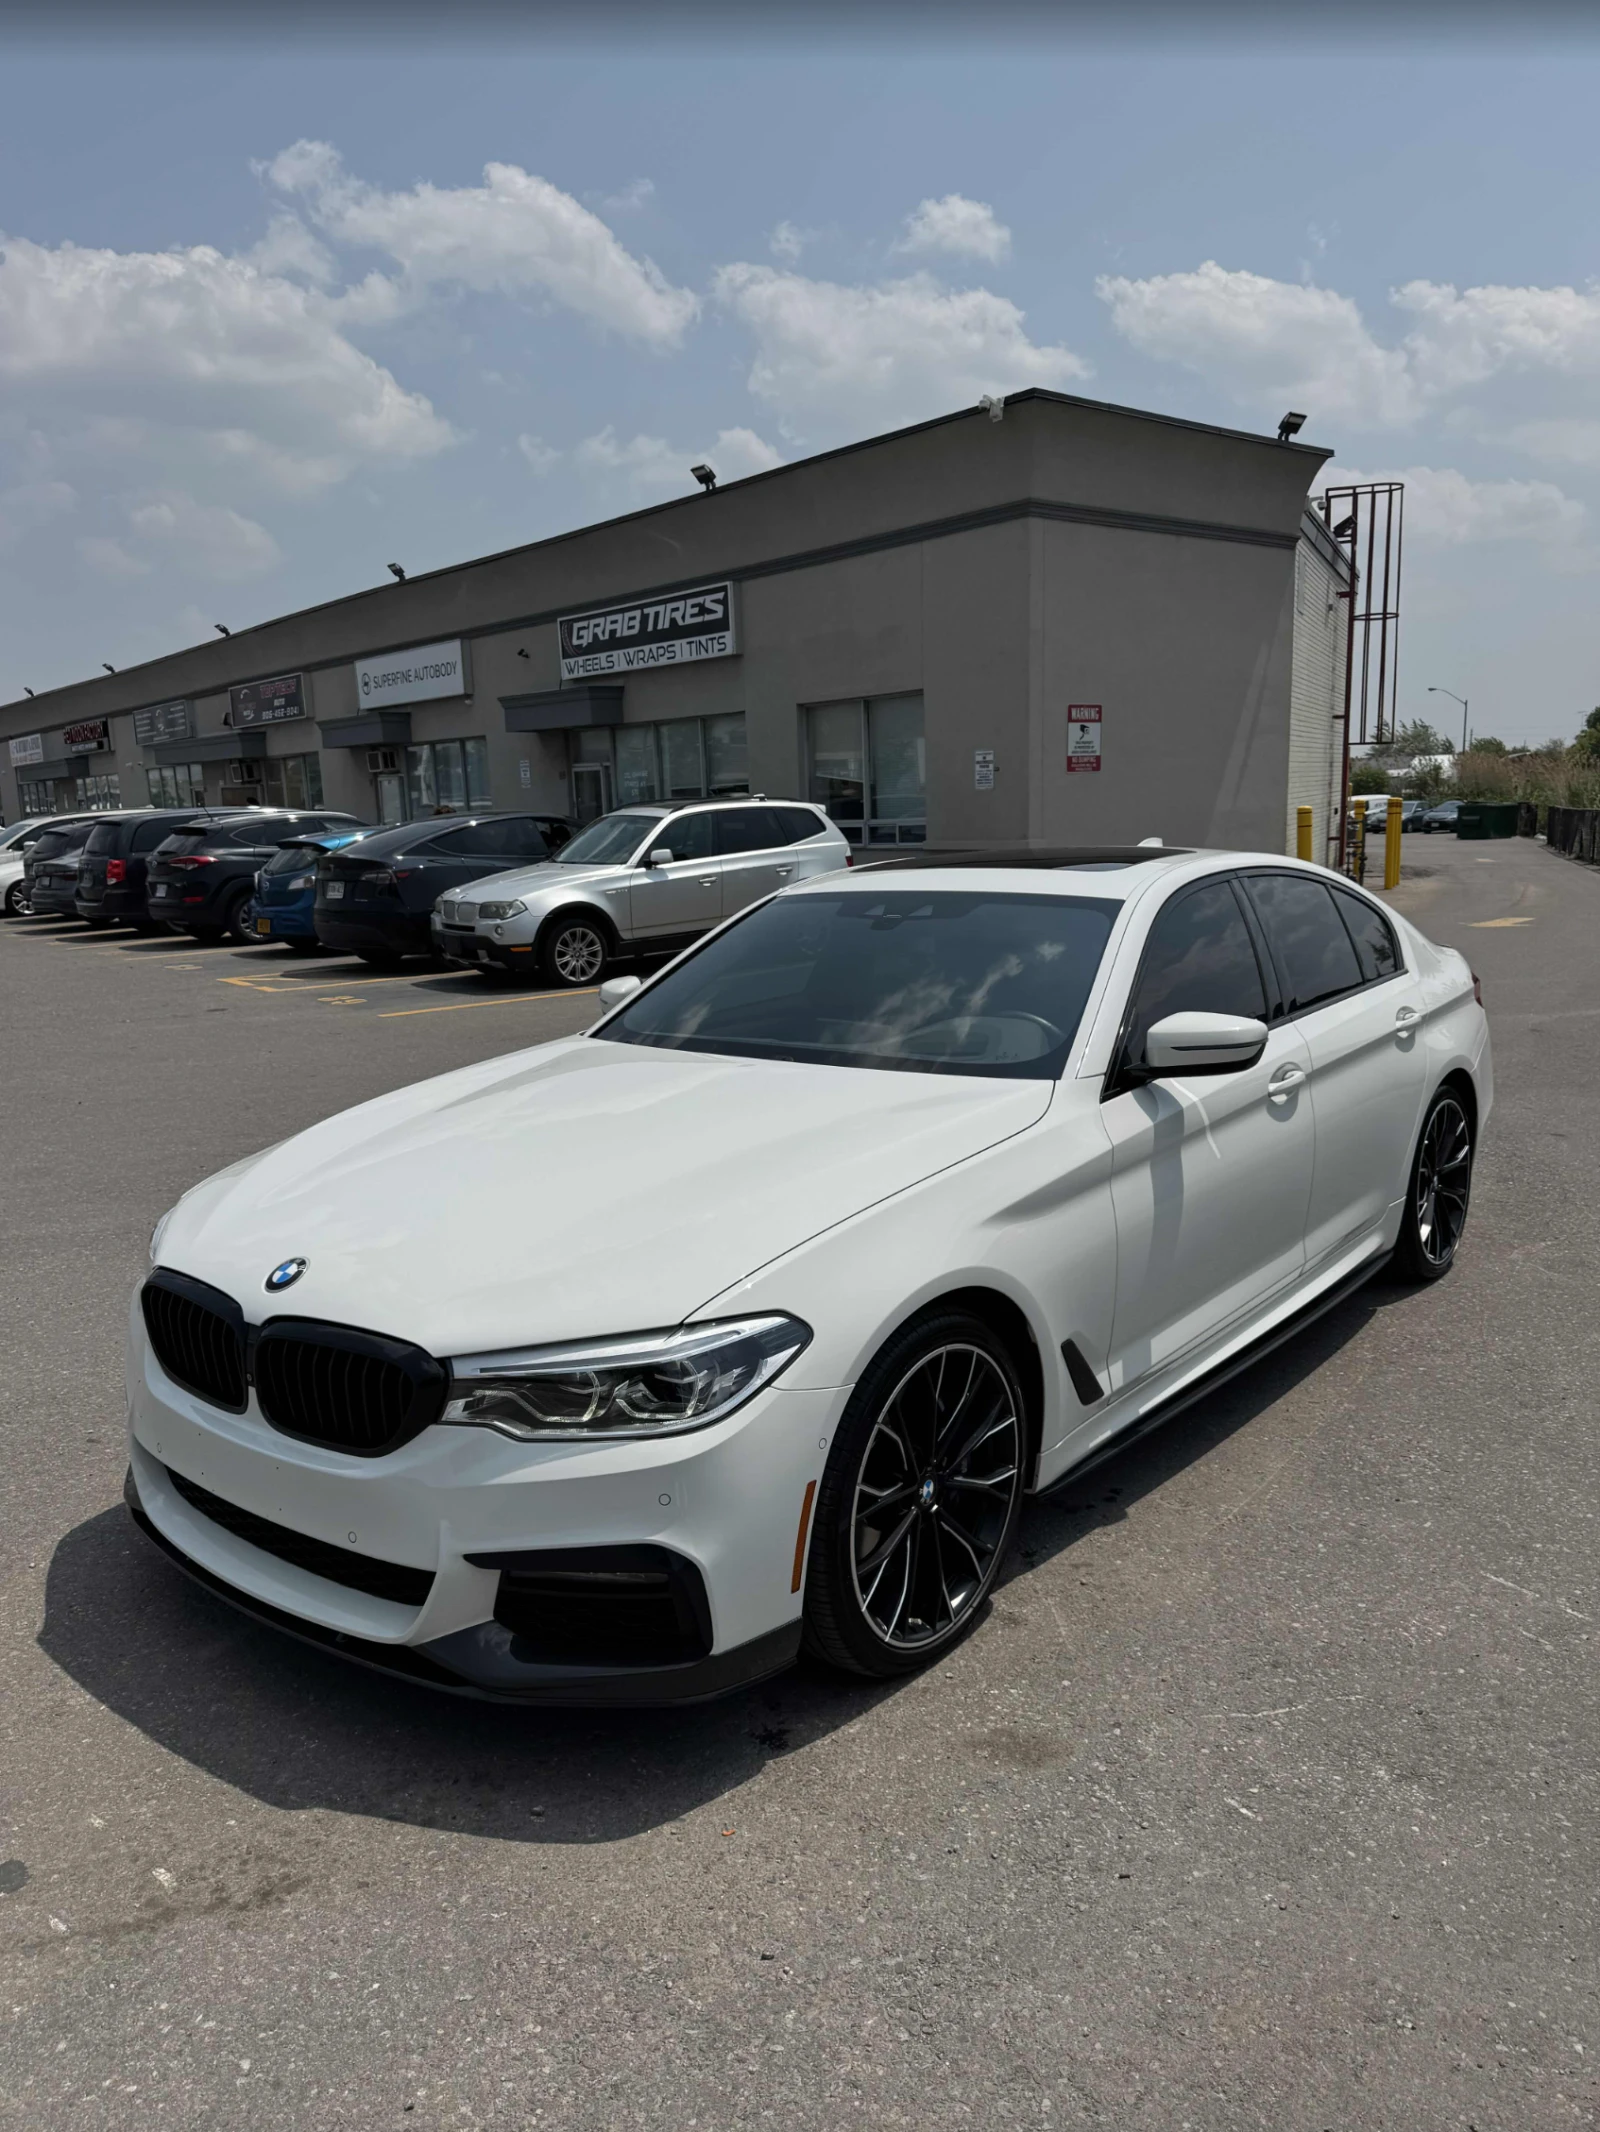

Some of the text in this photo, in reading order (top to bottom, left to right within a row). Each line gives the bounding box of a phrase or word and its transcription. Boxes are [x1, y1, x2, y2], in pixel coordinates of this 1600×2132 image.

[572, 592, 725, 648] GRAB TIRES
[565, 635, 727, 676] WHEELS WRAPS TINTS
[373, 660, 457, 689] SUPERFINE AUTOBODY
[1071, 707, 1099, 720] WARNING
